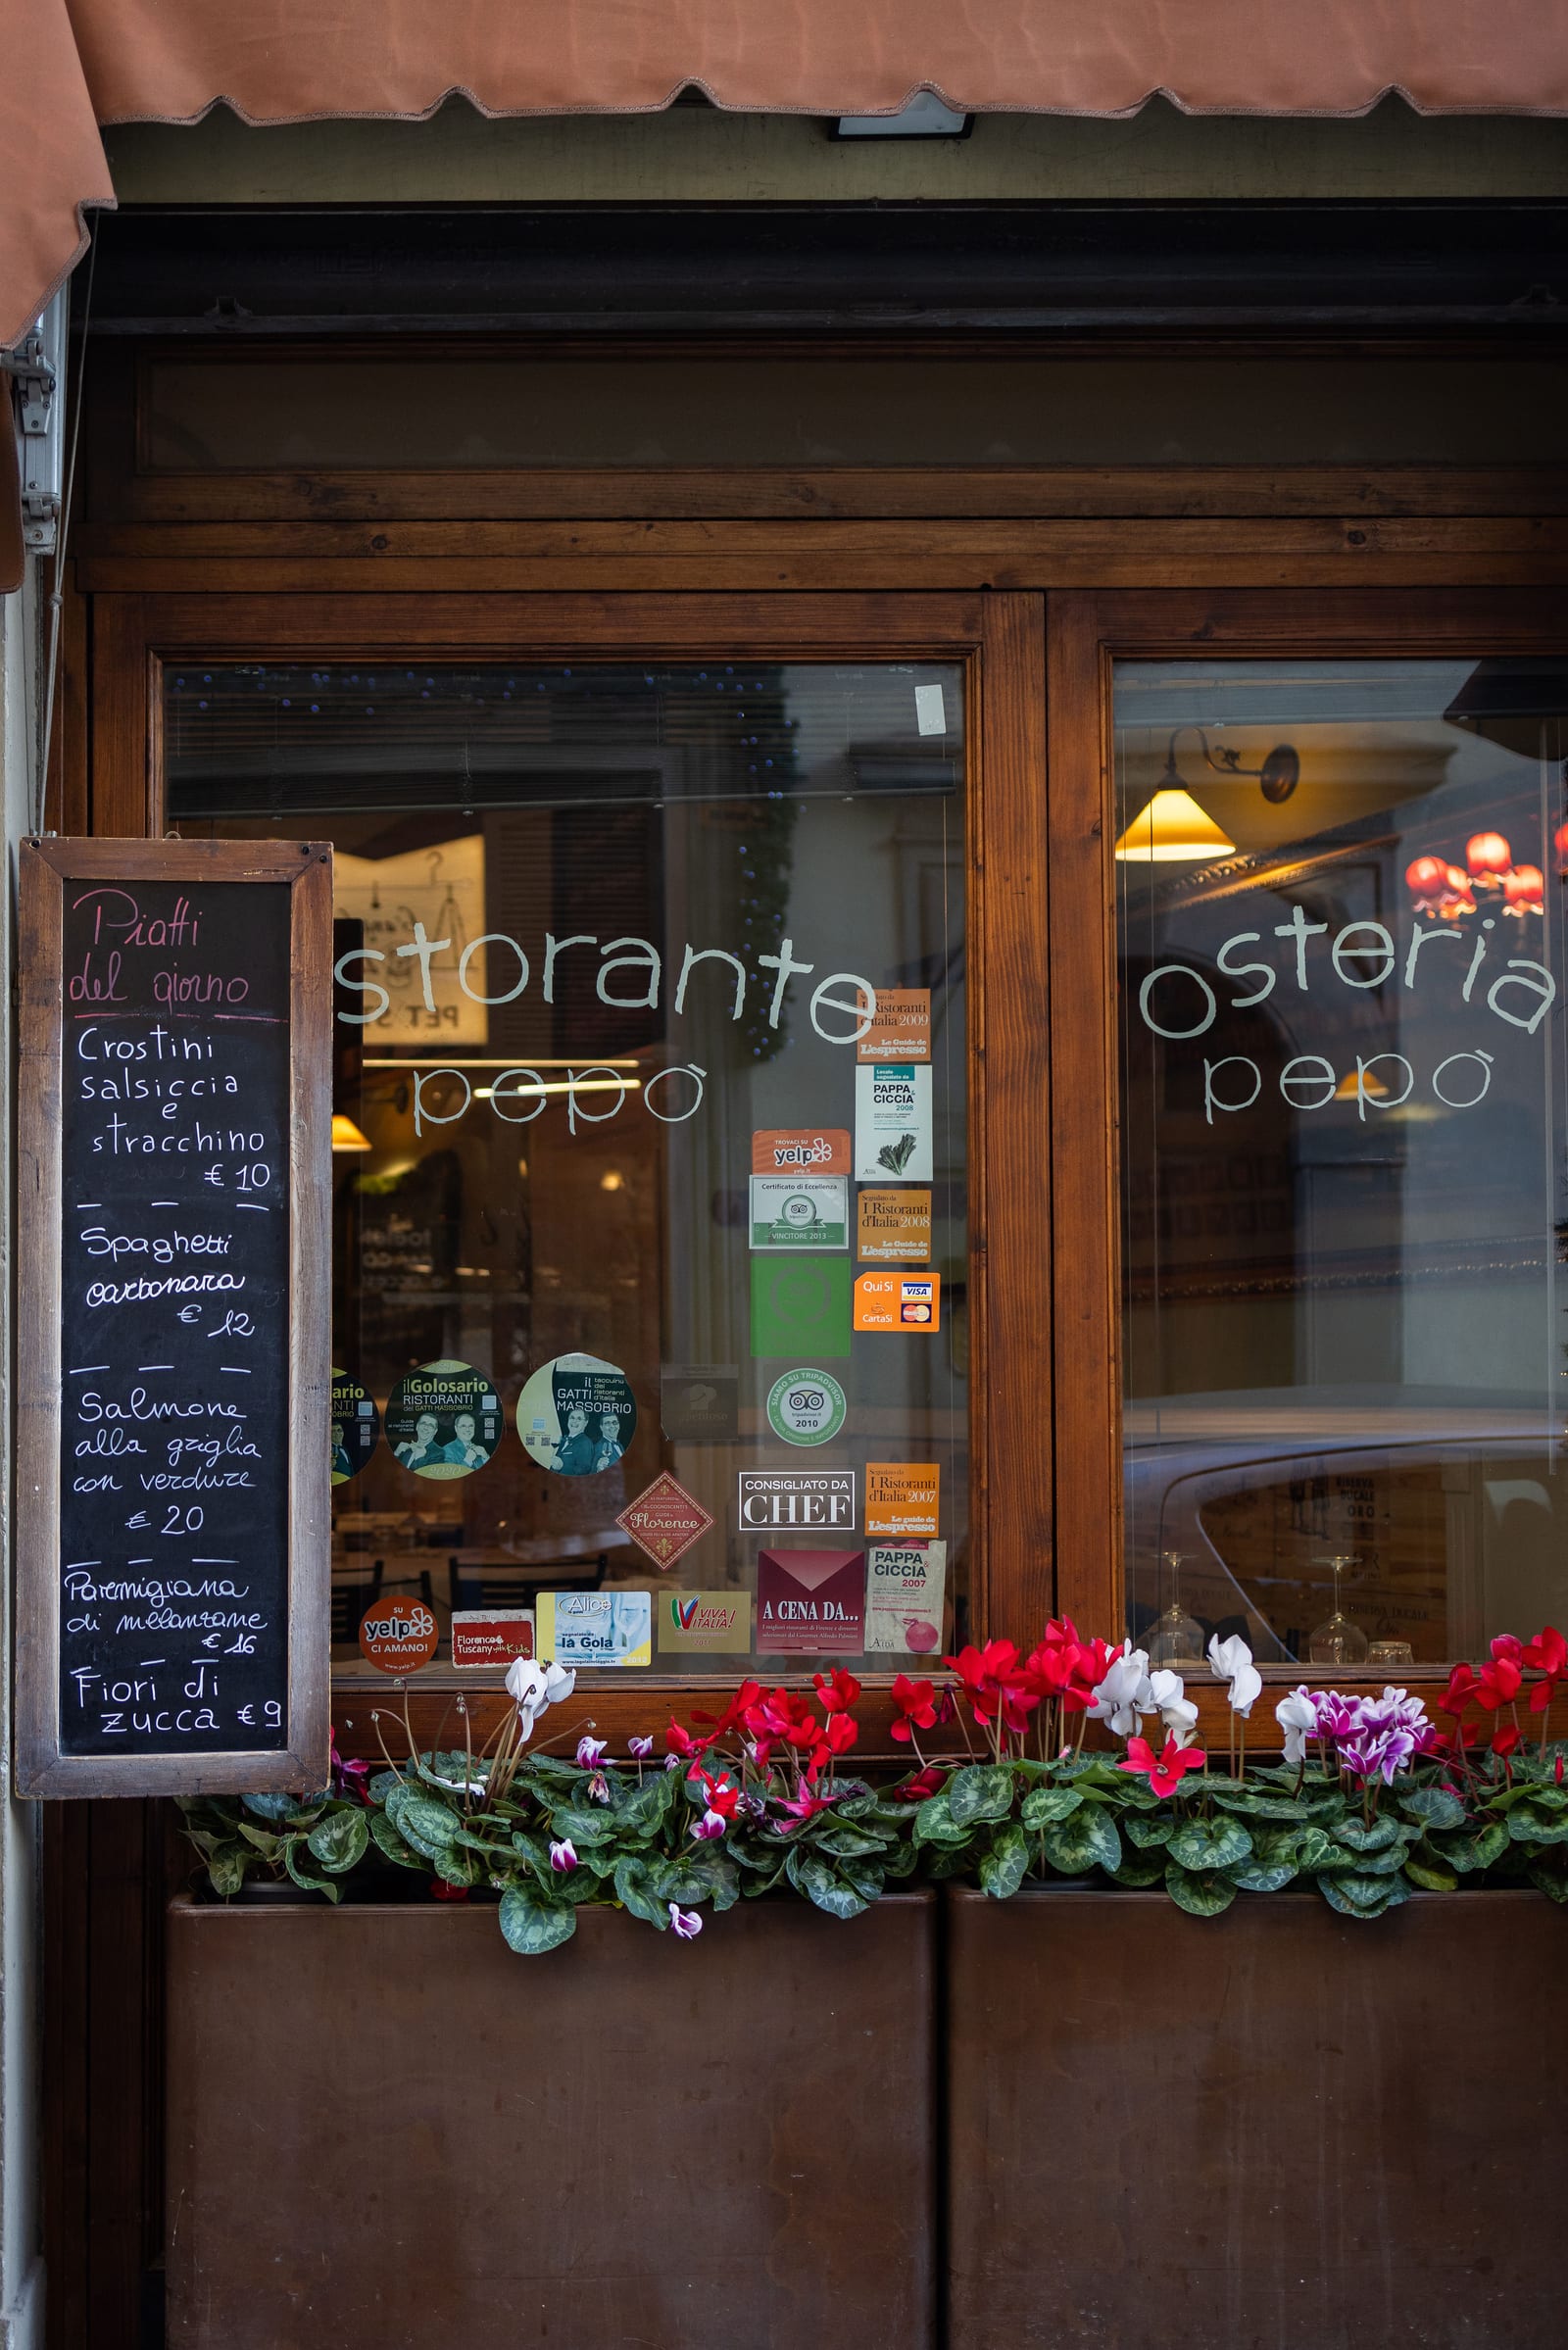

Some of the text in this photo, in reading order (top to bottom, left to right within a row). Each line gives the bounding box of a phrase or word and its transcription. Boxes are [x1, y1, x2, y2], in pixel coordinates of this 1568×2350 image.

[73, 889, 203, 947] Piatti
[70, 952, 250, 1013] del giorno
[899, 1014, 928, 1027] 2009
[78, 1024, 214, 1061] Crostini
[81, 1068, 239, 1101] salsiccia
[873, 1084, 911, 1094] PAPPA
[873, 1094, 914, 1104] CICCIA
[162, 1102, 178, 1119] e
[93, 1112, 265, 1155] stracchino
[774, 1147, 812, 1166] yelp
[204, 1163, 270, 1191] € 10
[873, 1202, 928, 1215] Ristoranti
[862, 1215, 930, 1228] d'Italia 2008
[80, 1227, 233, 1263] Spaghetti
[863, 1281, 893, 1293] Qui Si
[862, 1314, 893, 1323] CartaSi
[584, 1377, 592, 1388] il
[771, 1372, 842, 1406] SIAMO SU TRIPADVISOR
[403, 1394, 473, 1405] RISTORANTI
[557, 1389, 592, 1400] GATTI
[78, 1389, 247, 1423] Salmone
[557, 1401, 632, 1414] MASSOBRIO
[74, 1425, 262, 1468] alla griglia
[74, 1469, 257, 1493] con verdure
[745, 1480, 849, 1490] CONSIGLIATO DA
[880, 1476, 936, 1489] Ristoranti
[869, 1489, 936, 1502] d'Italia 2007
[743, 1494, 851, 1524] CHEF
[161, 1505, 204, 1536] 20
[630, 1512, 700, 1529] Florence
[874, 1551, 922, 1564] PAPPA
[874, 1564, 926, 1578] CICCIA
[902, 1579, 926, 1588] 2007
[569, 1596, 612, 1612] Alice
[762, 1600, 858, 1621] A CENA DA...
[67, 1607, 269, 1635] di melanzane
[700, 1609, 727, 1619] VIVA
[366, 1617, 411, 1640] yelp
[223, 1634, 258, 1654] 16
[371, 1643, 428, 1653] CI AMANO!
[457, 1644, 493, 1655] Tuscany
[506, 1643, 530, 1654] Kids
[562, 1637, 613, 1648] la Gola
[74, 1666, 219, 1708] Fiori di
[100, 1708, 220, 1734] zucca
